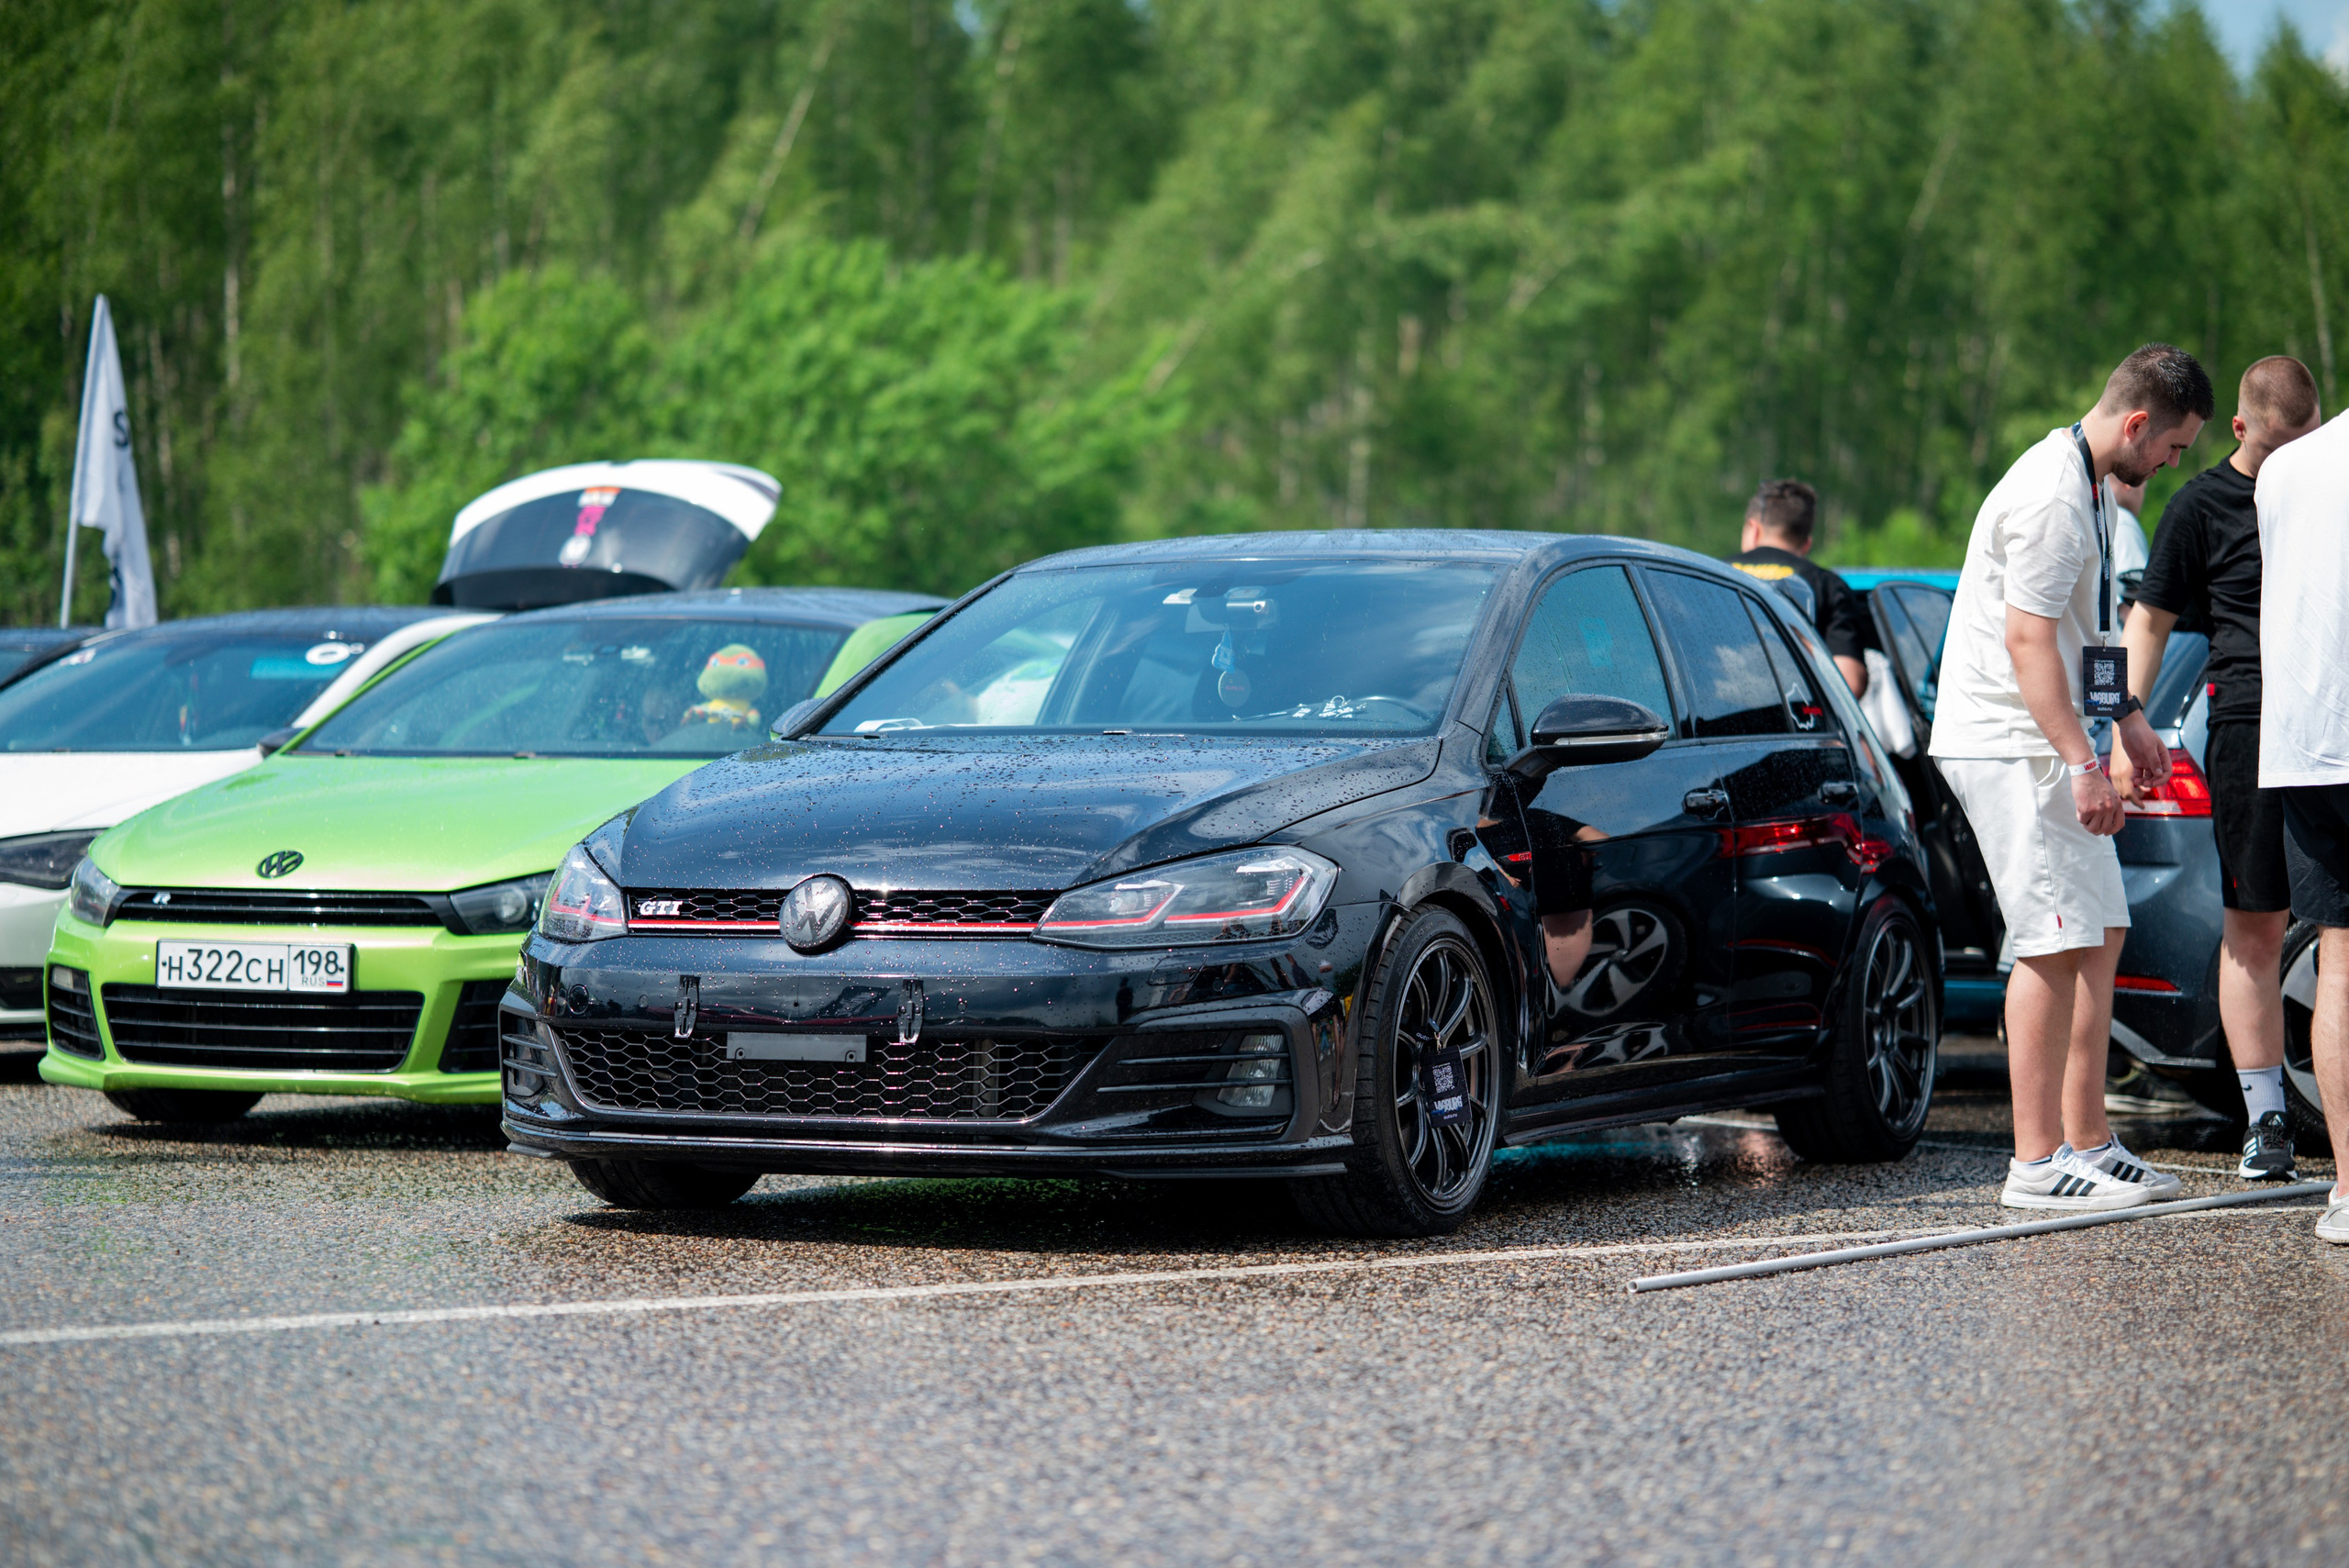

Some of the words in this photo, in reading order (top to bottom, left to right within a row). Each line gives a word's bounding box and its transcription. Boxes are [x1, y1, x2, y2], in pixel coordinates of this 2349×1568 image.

[640, 900, 684, 917] GTI
[293, 950, 339, 976] 198
[301, 976, 326, 987] RUS
